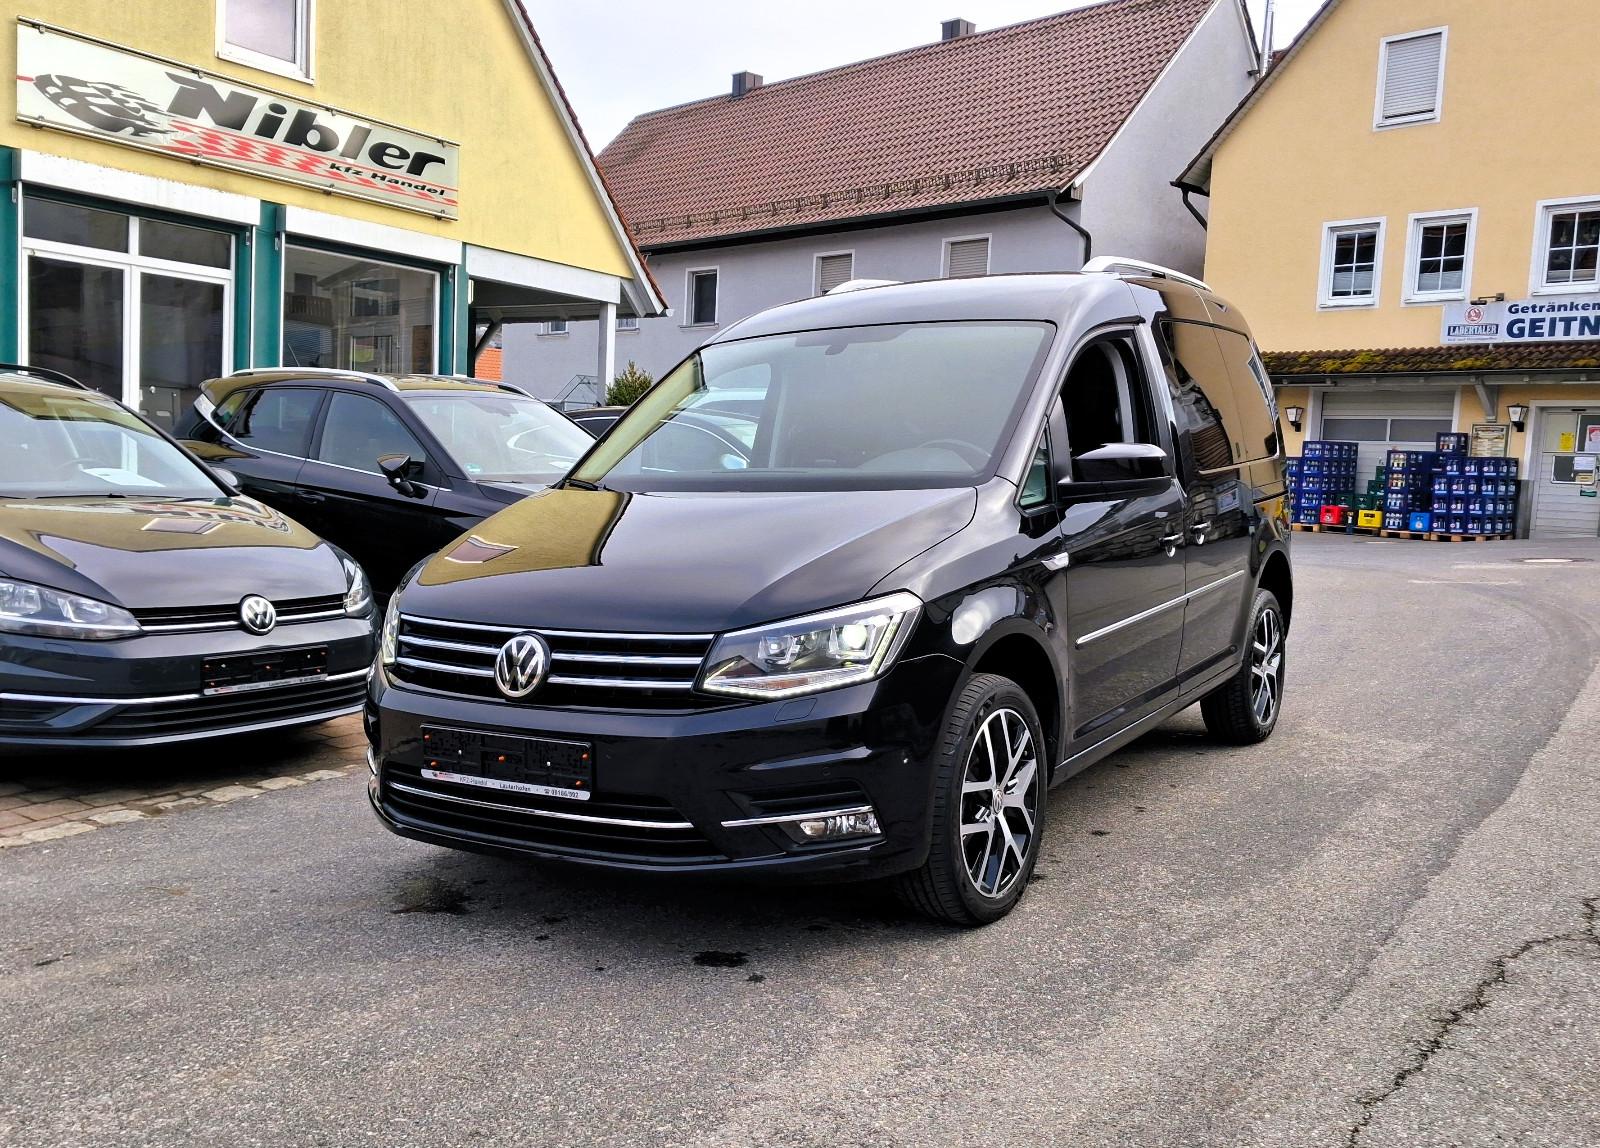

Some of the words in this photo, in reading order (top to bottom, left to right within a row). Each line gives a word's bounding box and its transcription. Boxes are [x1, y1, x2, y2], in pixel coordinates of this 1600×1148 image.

[165, 71, 446, 176] Nibler
[371, 172, 446, 196] Handel
[1506, 315, 1600, 338] GEITN
[494, 635, 545, 698] VW
